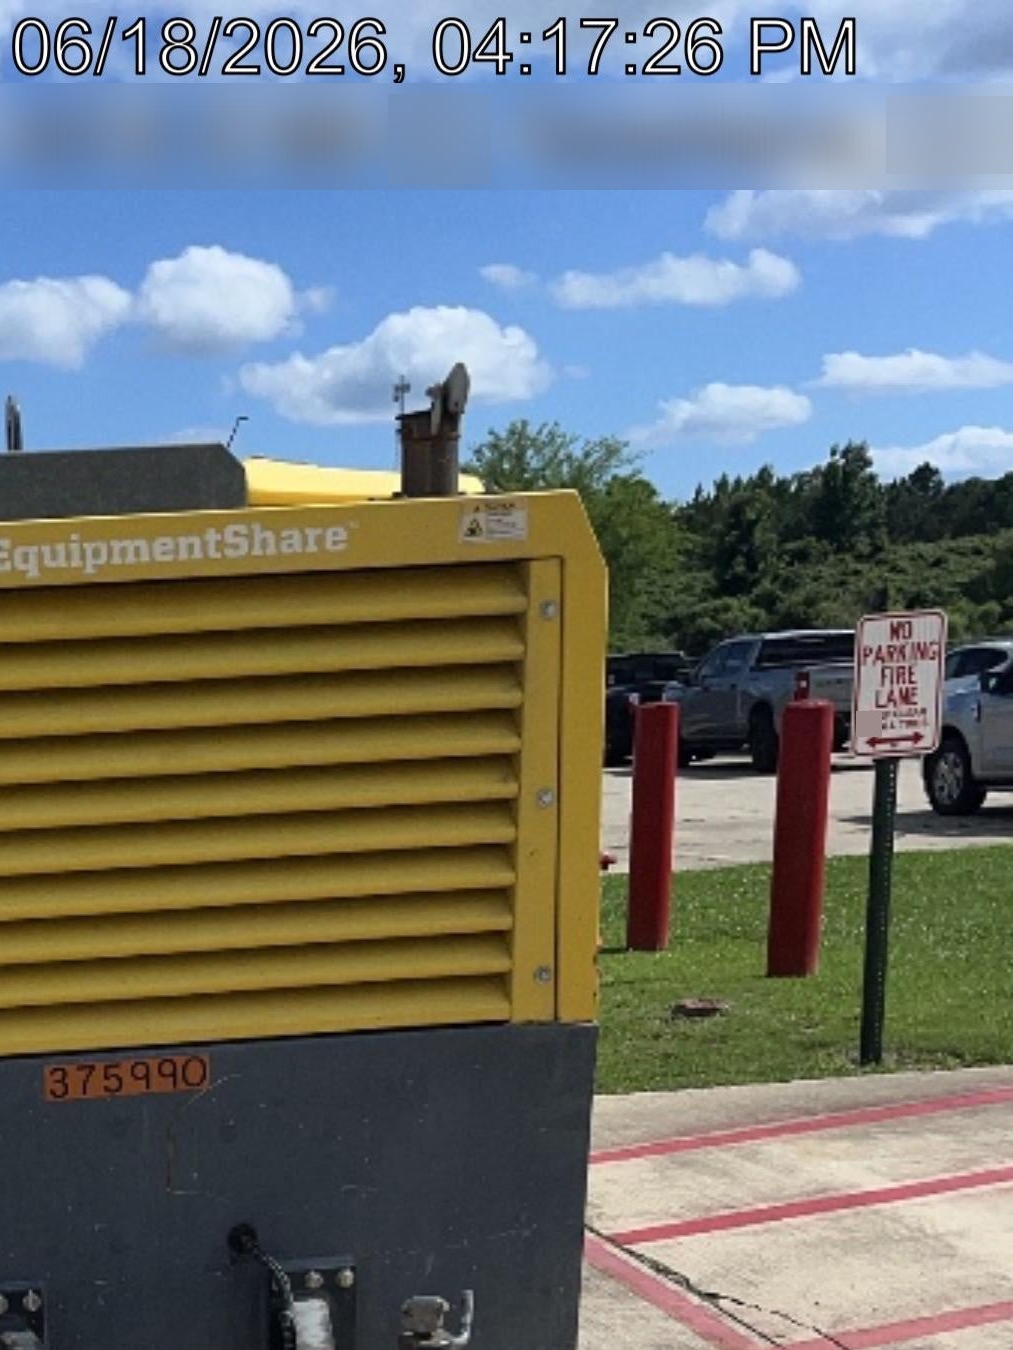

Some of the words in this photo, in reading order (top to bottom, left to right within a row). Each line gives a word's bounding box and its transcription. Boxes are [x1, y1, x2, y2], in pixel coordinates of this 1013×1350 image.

[889, 620, 913, 641] NO
[863, 641, 940, 665] PARKING
[881, 665, 917, 687] FIRE
[875, 687, 918, 708] LANE
[48, 1055, 208, 1099] 375990
